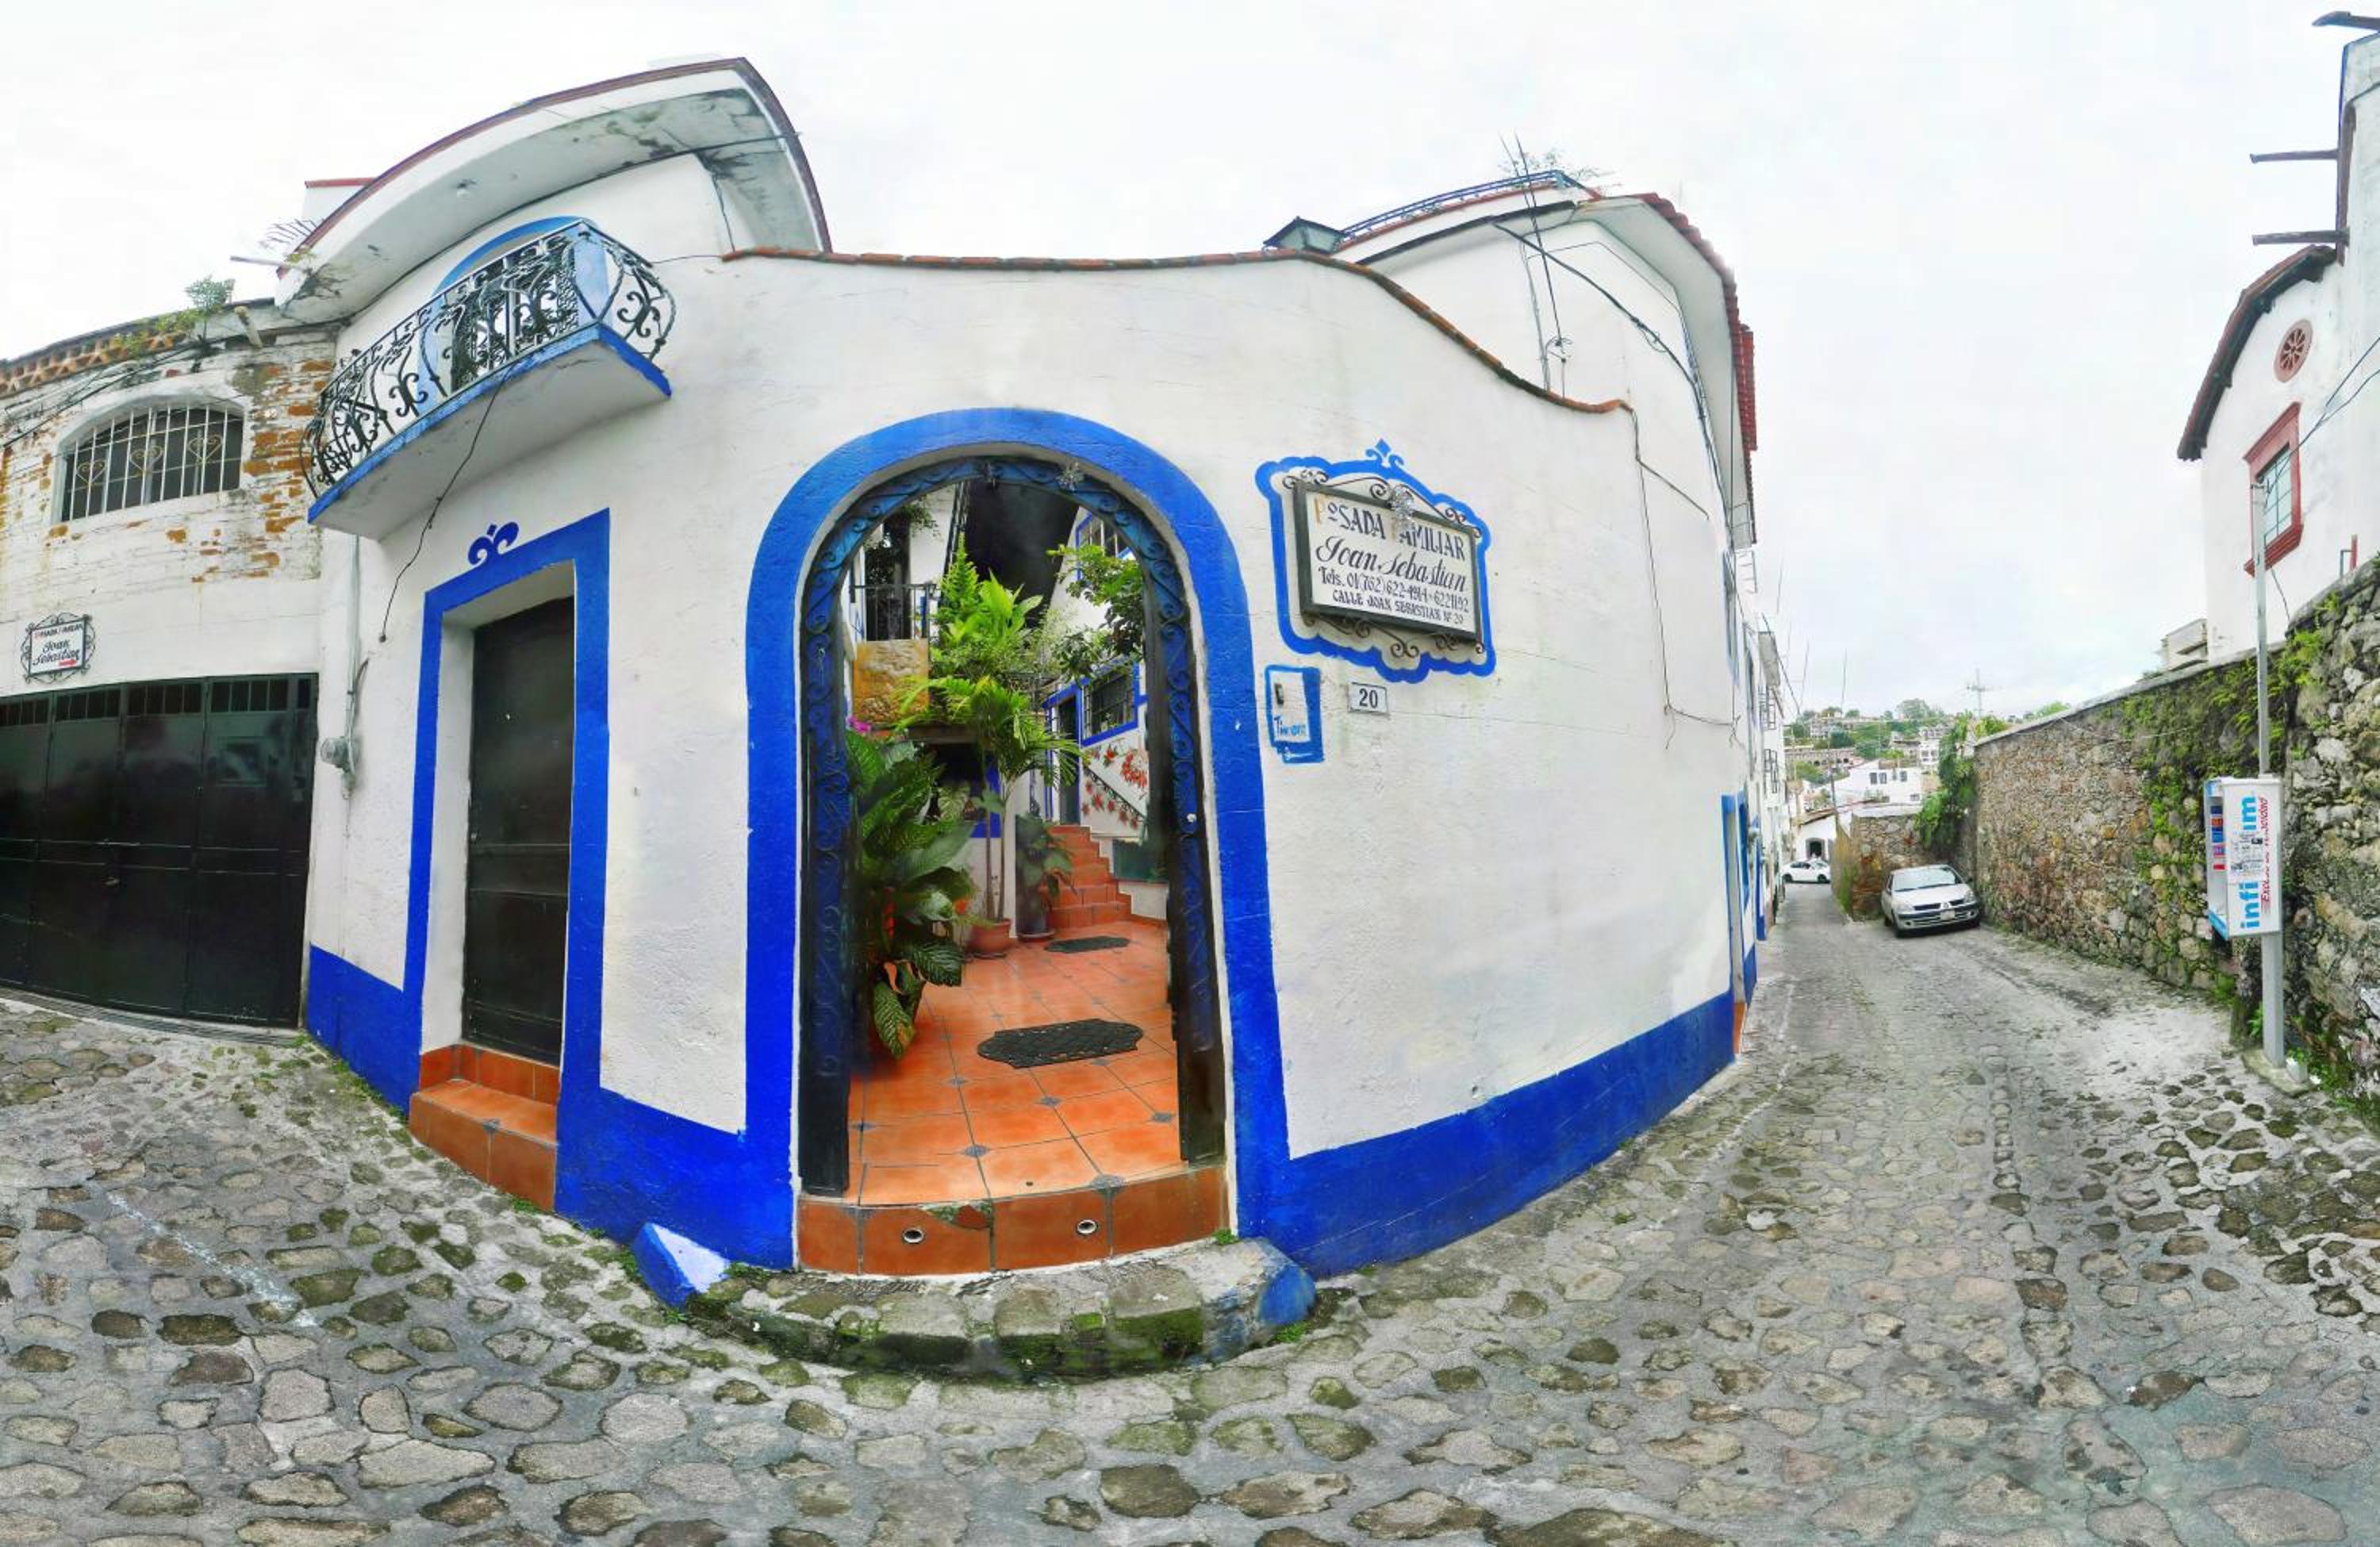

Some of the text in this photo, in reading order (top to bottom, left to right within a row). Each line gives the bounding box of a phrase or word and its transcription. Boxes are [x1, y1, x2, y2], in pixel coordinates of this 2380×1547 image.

[1315, 535, 1466, 592] Joan Sebastian
[1318, 566, 1345, 587] Tels.
[1333, 589, 1364, 605] CALLE
[1358, 688, 1379, 709] 20
